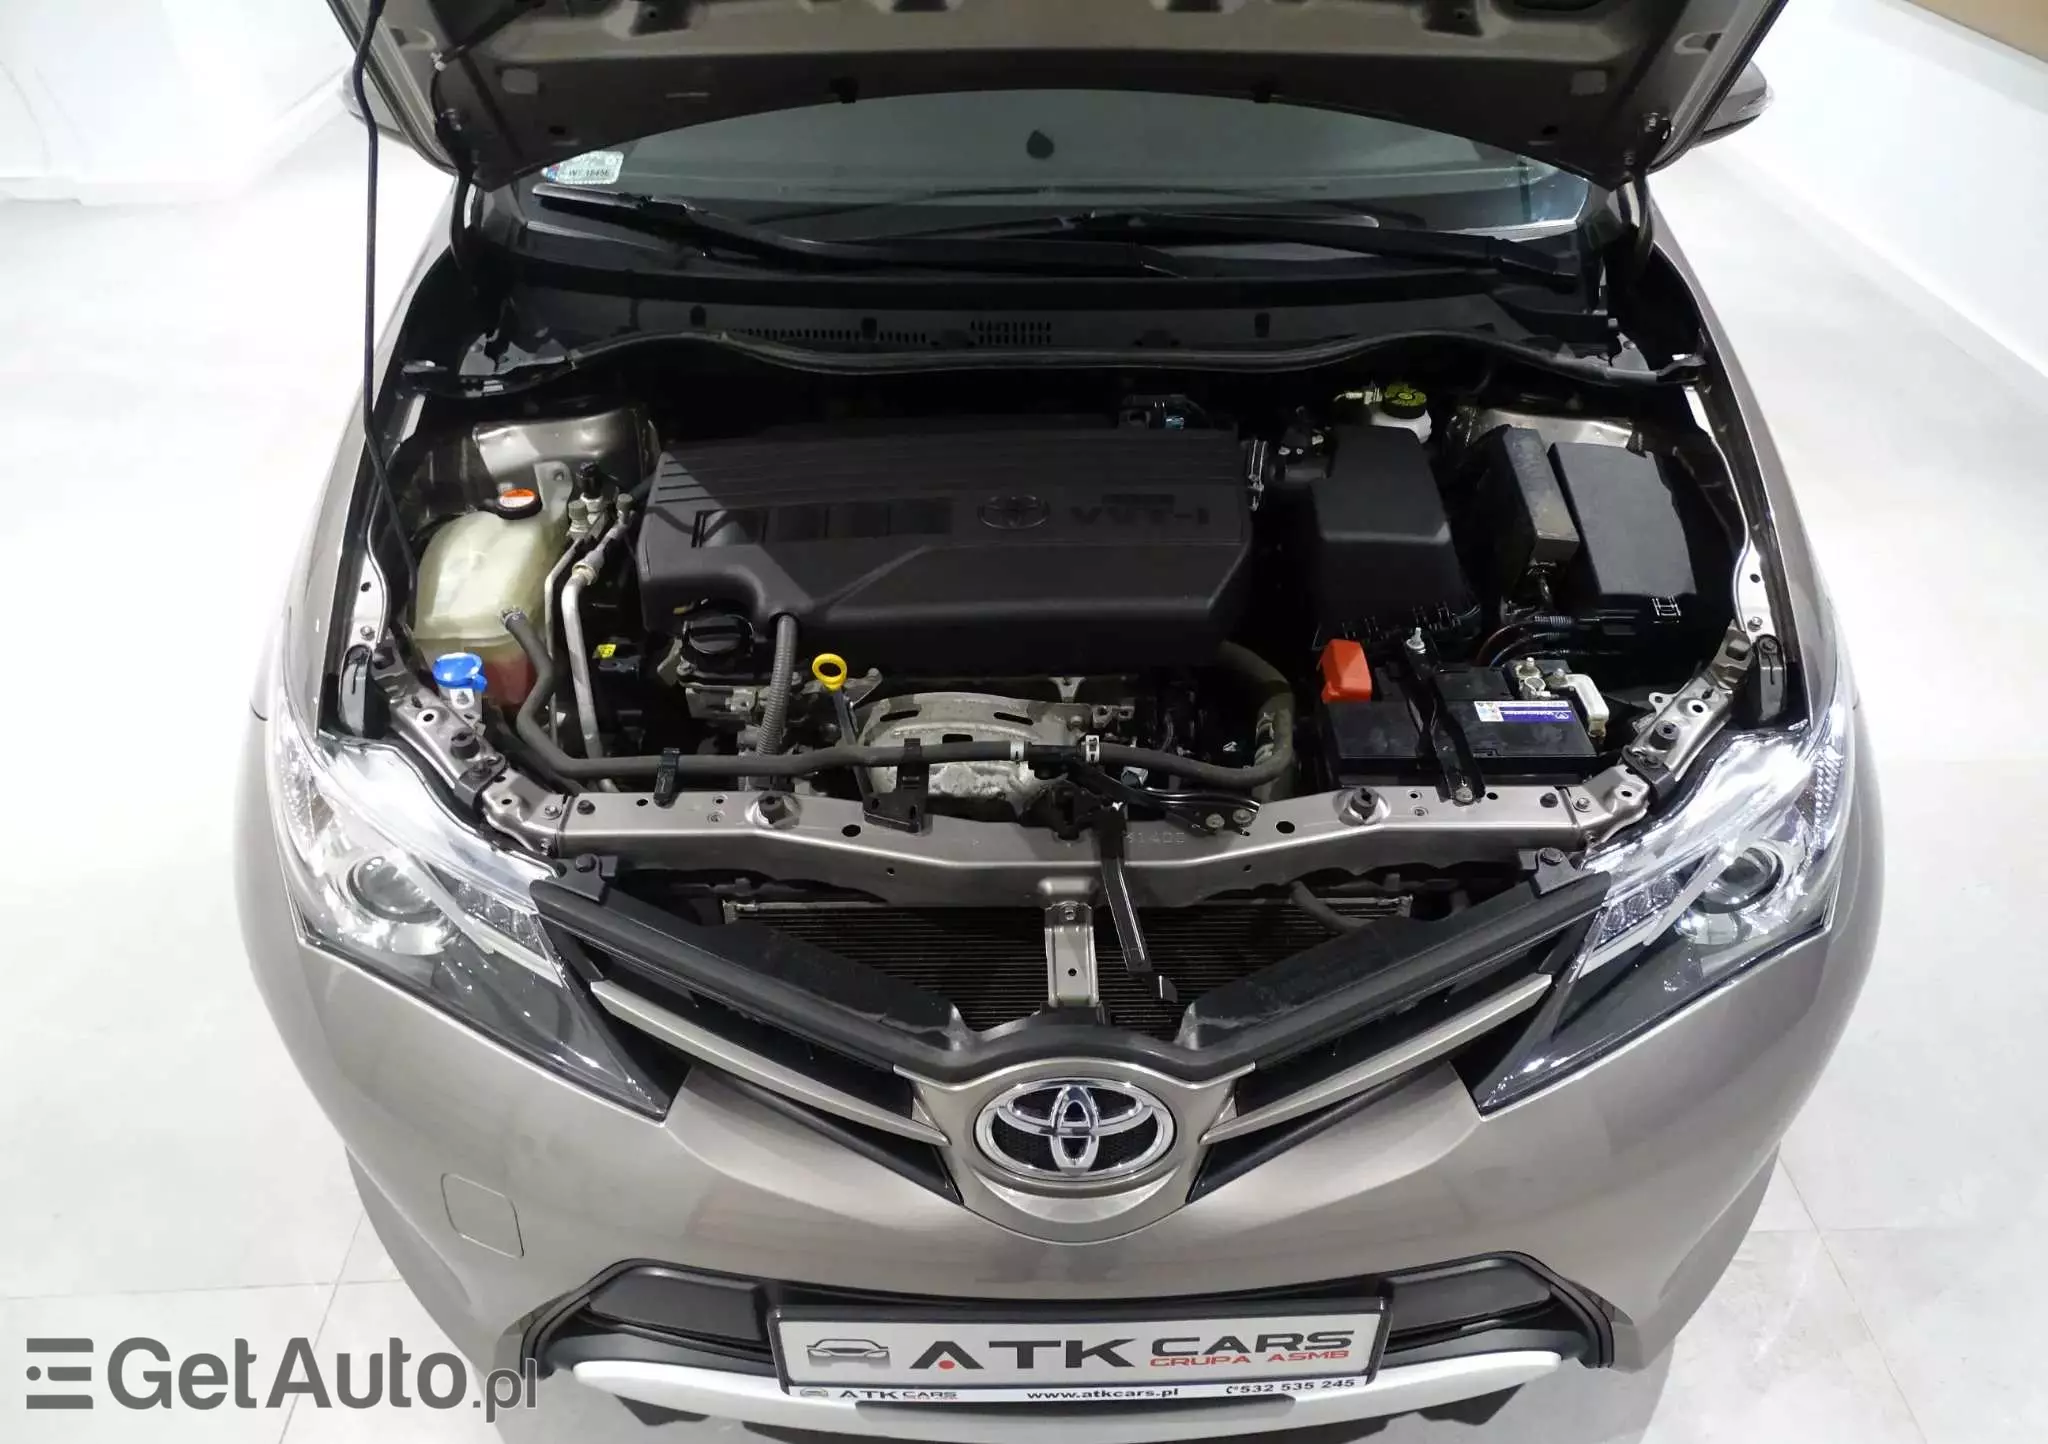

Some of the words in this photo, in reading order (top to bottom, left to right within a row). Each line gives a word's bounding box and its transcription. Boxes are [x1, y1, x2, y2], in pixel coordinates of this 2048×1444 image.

[909, 1338, 1137, 1369] ATK
[1151, 1330, 1354, 1356] CARS
[1150, 1355, 1251, 1367] GRUPA
[1267, 1350, 1349, 1362] ASMB
[1027, 1388, 1179, 1398] www.atkcars.pl
[1240, 1384, 1274, 1393] 532
[1281, 1382, 1315, 1391] 535
[1321, 1379, 1355, 1388] 245
[840, 1389, 899, 1399] ATK
[902, 1390, 958, 1398] CARS
